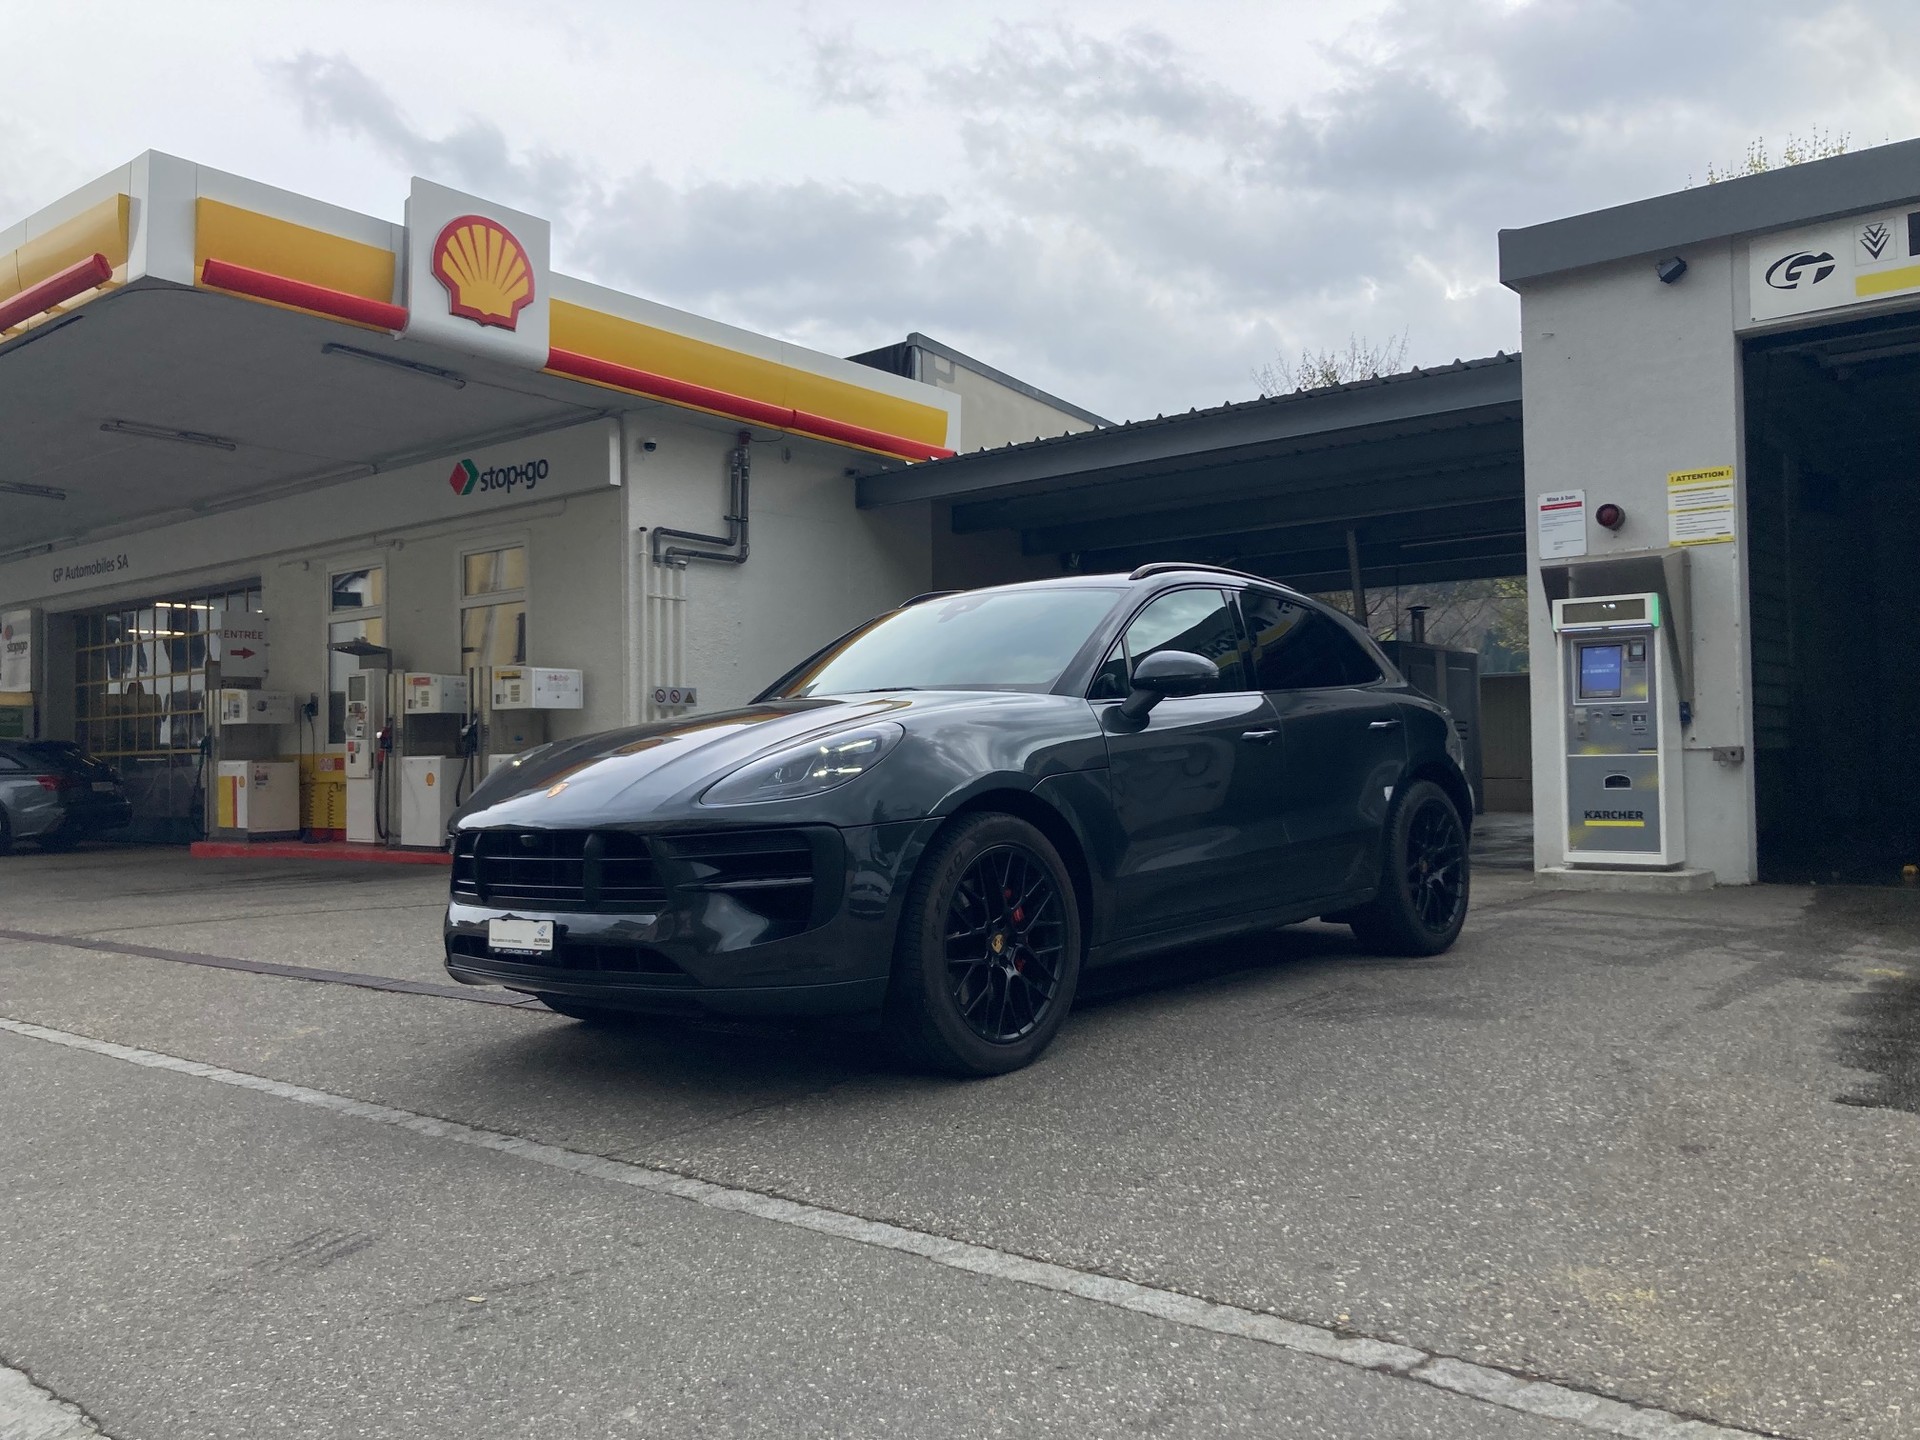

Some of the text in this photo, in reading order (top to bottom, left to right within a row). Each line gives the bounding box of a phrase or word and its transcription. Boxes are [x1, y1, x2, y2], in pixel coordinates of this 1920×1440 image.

[480, 459, 549, 493] stop+go
[1676, 470, 1724, 482] ATTENTION
[53, 553, 129, 583] GP Automobiles SA
[223, 629, 264, 640] ENTRÉE
[1584, 809, 1644, 819] KÄRCHER
